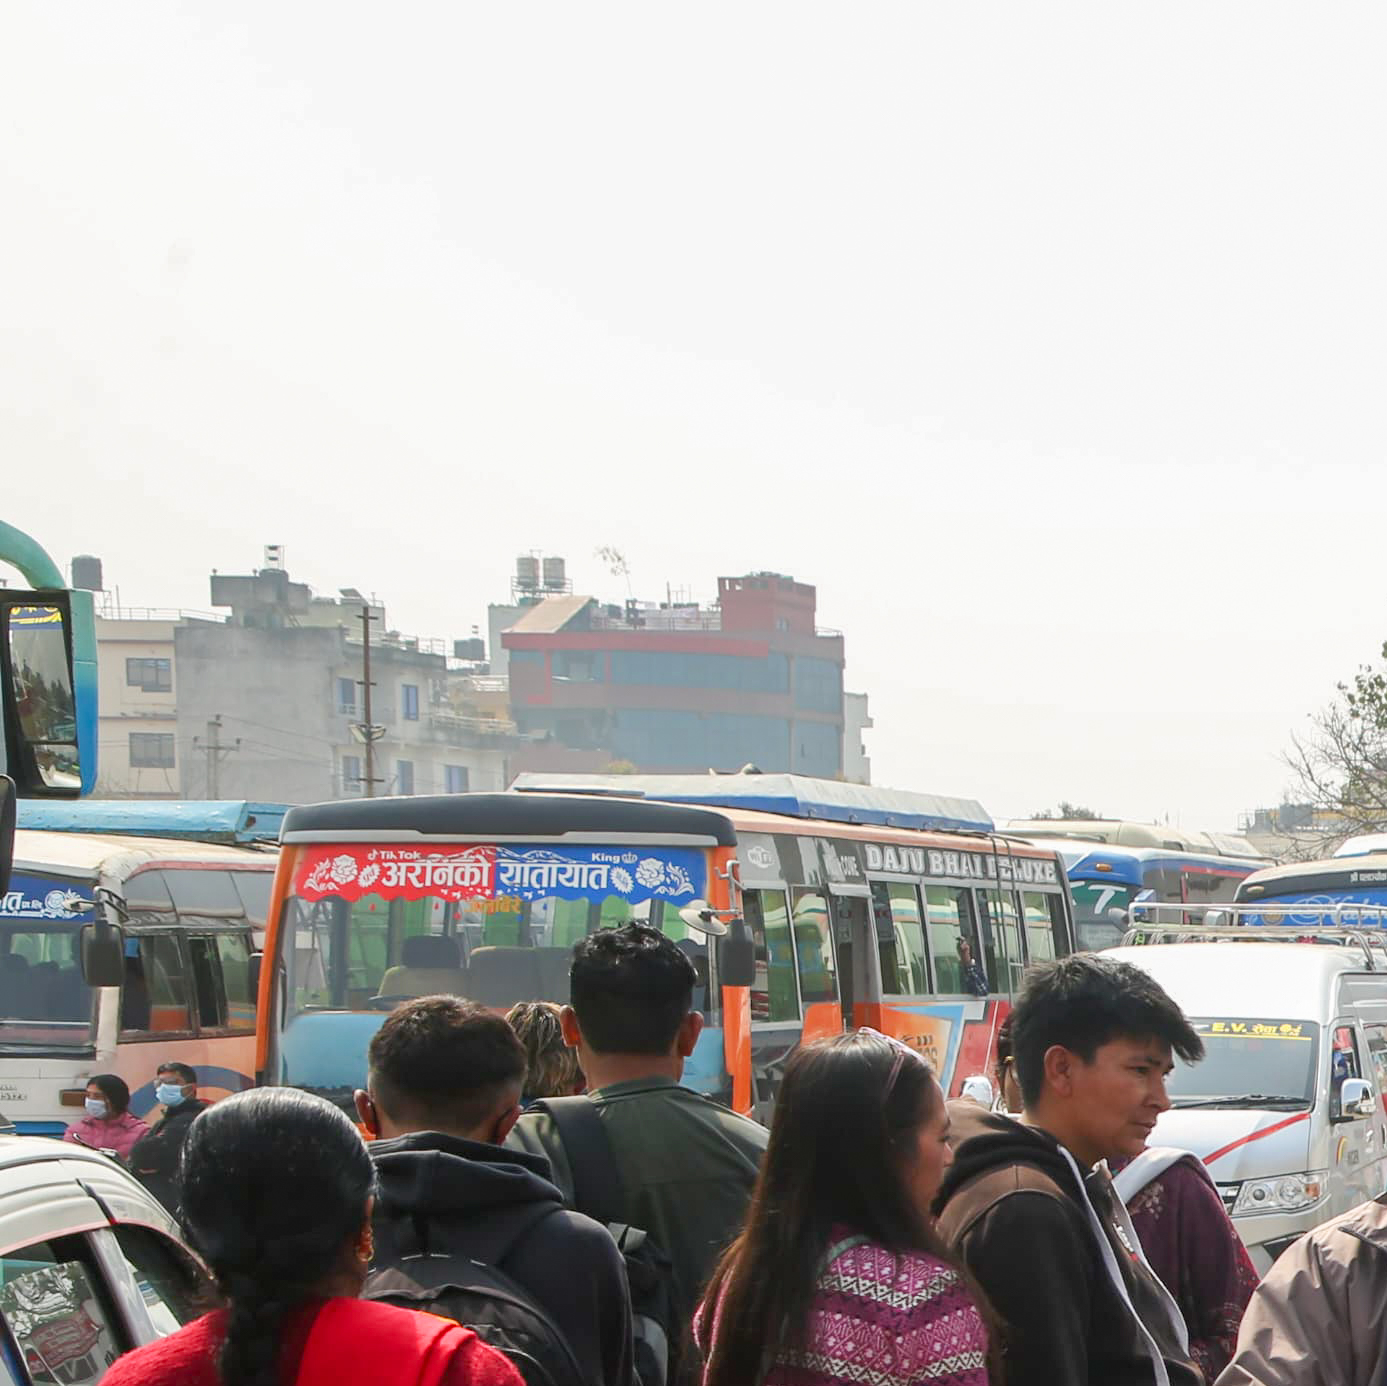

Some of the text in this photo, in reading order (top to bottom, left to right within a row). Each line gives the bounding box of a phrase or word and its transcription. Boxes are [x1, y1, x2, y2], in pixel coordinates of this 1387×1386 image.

[381, 855, 491, 888] अरनिको
[500, 863, 610, 890] यातायात
[591, 852, 621, 863] King
[865, 844, 926, 873] DAJU
[928, 849, 984, 878] BHAI
